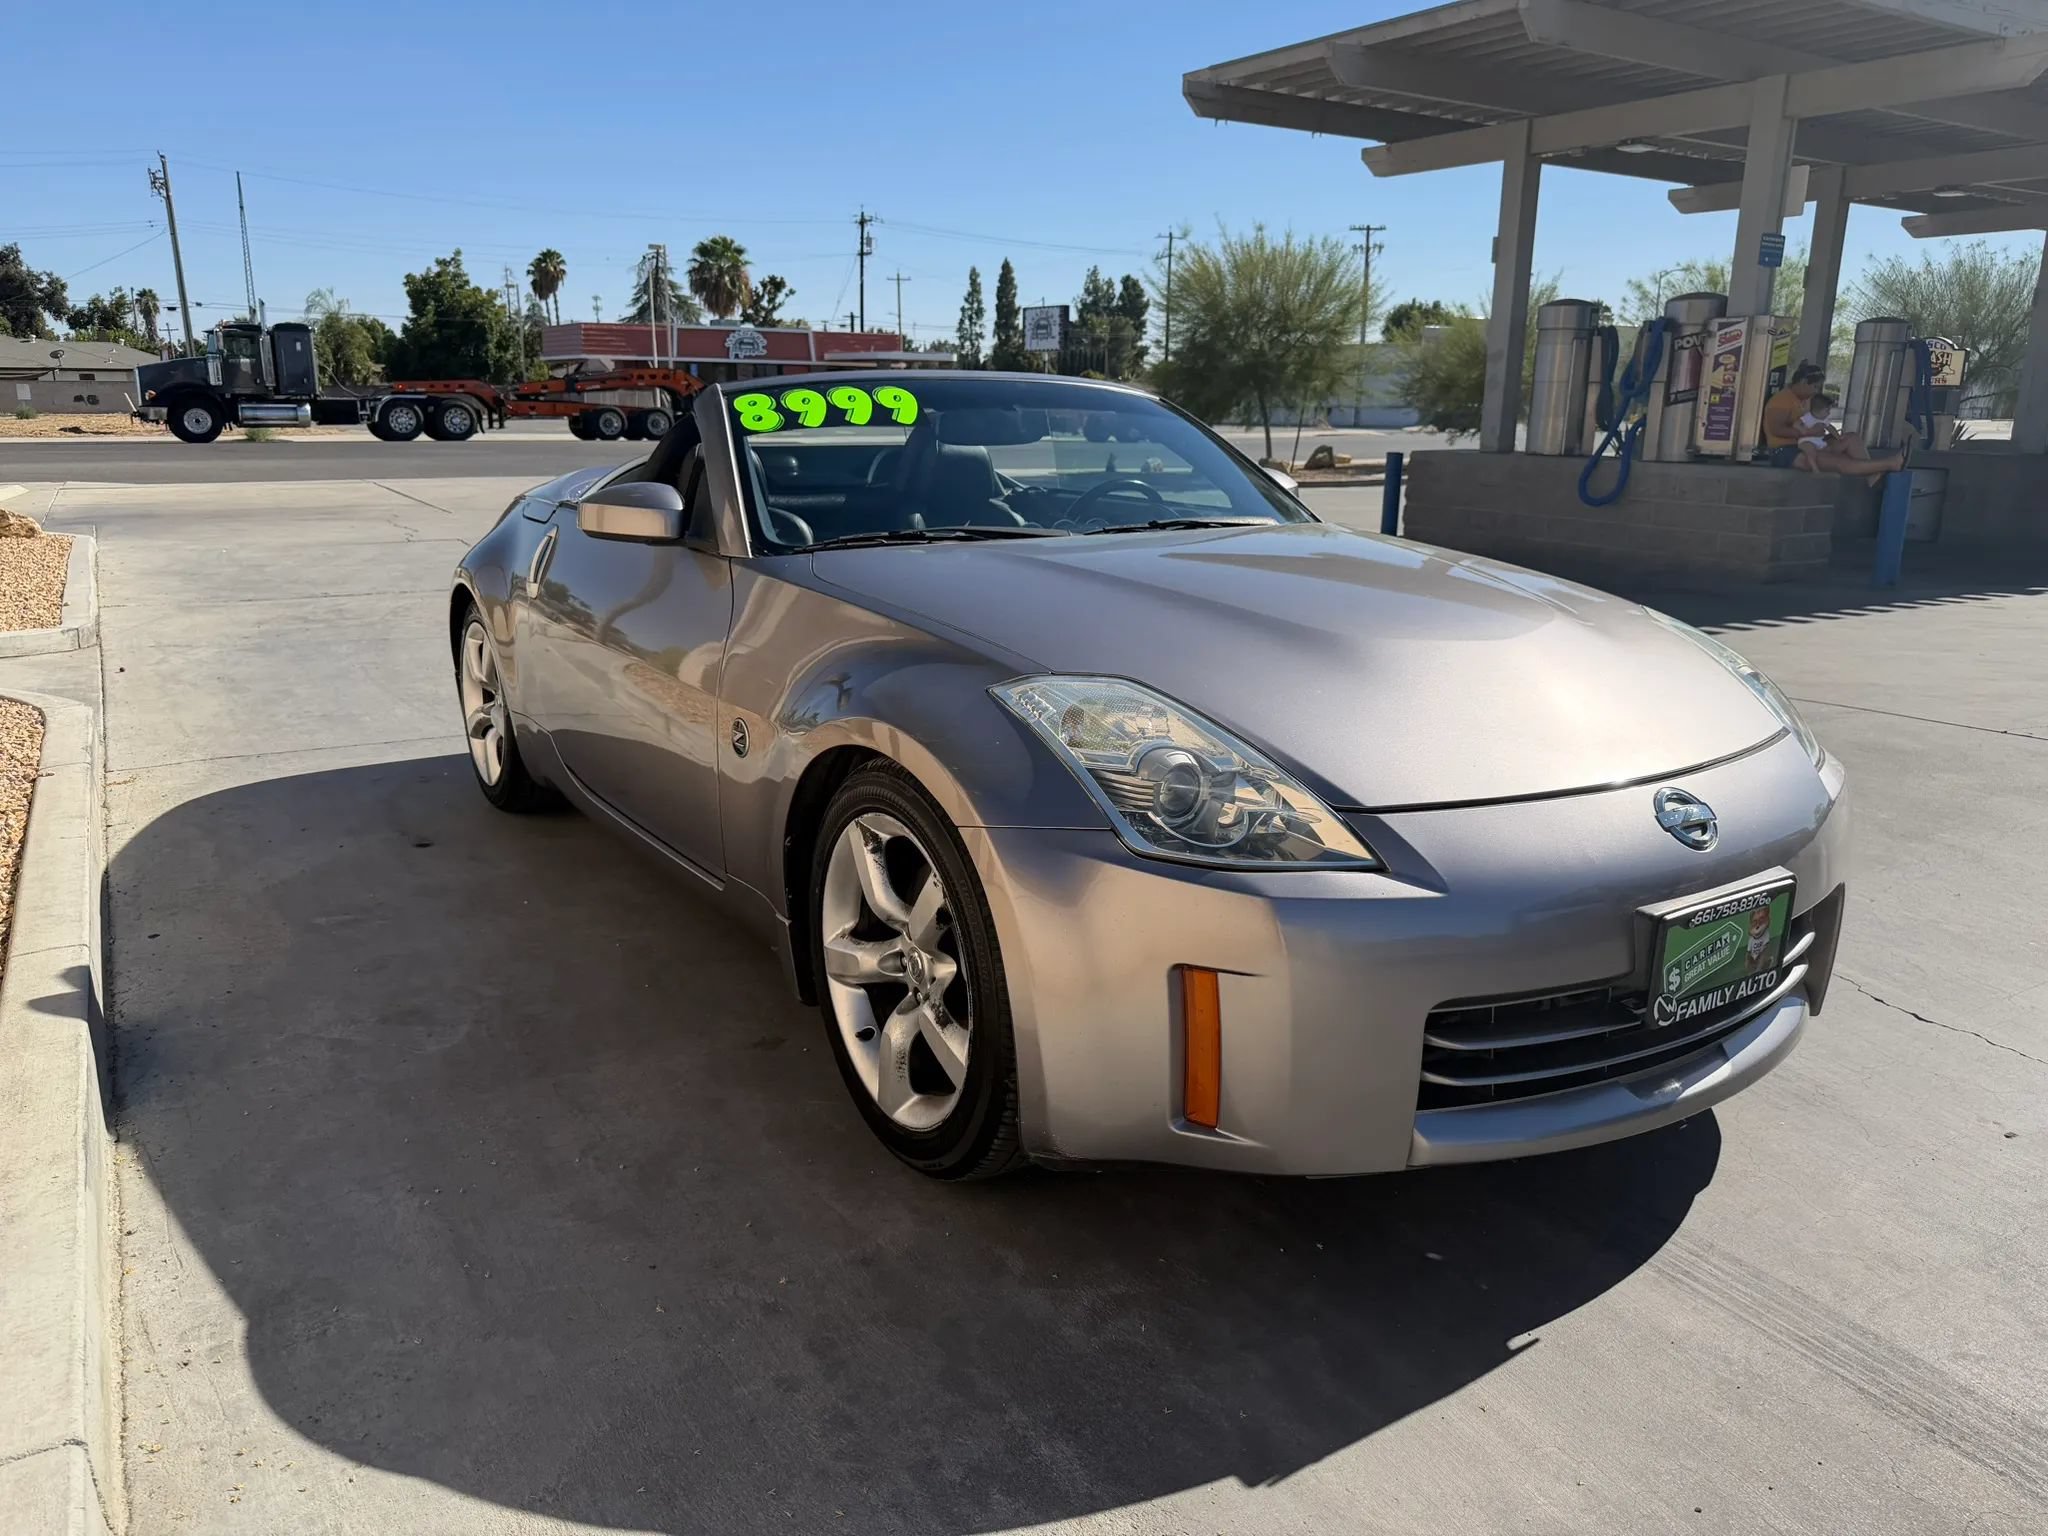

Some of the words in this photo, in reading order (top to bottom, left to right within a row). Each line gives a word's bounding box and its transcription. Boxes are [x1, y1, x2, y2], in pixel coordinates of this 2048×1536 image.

[1930, 350, 1952, 365] ASH
[733, 386, 919, 432] 8999
[1685, 932, 1730, 969] CARFAX
[1685, 960, 1706, 982] GREAT
[1708, 945, 1730, 966] VALUE
[1675, 985, 1733, 1021] FAMILY
[1736, 970, 1777, 998] AUTO
